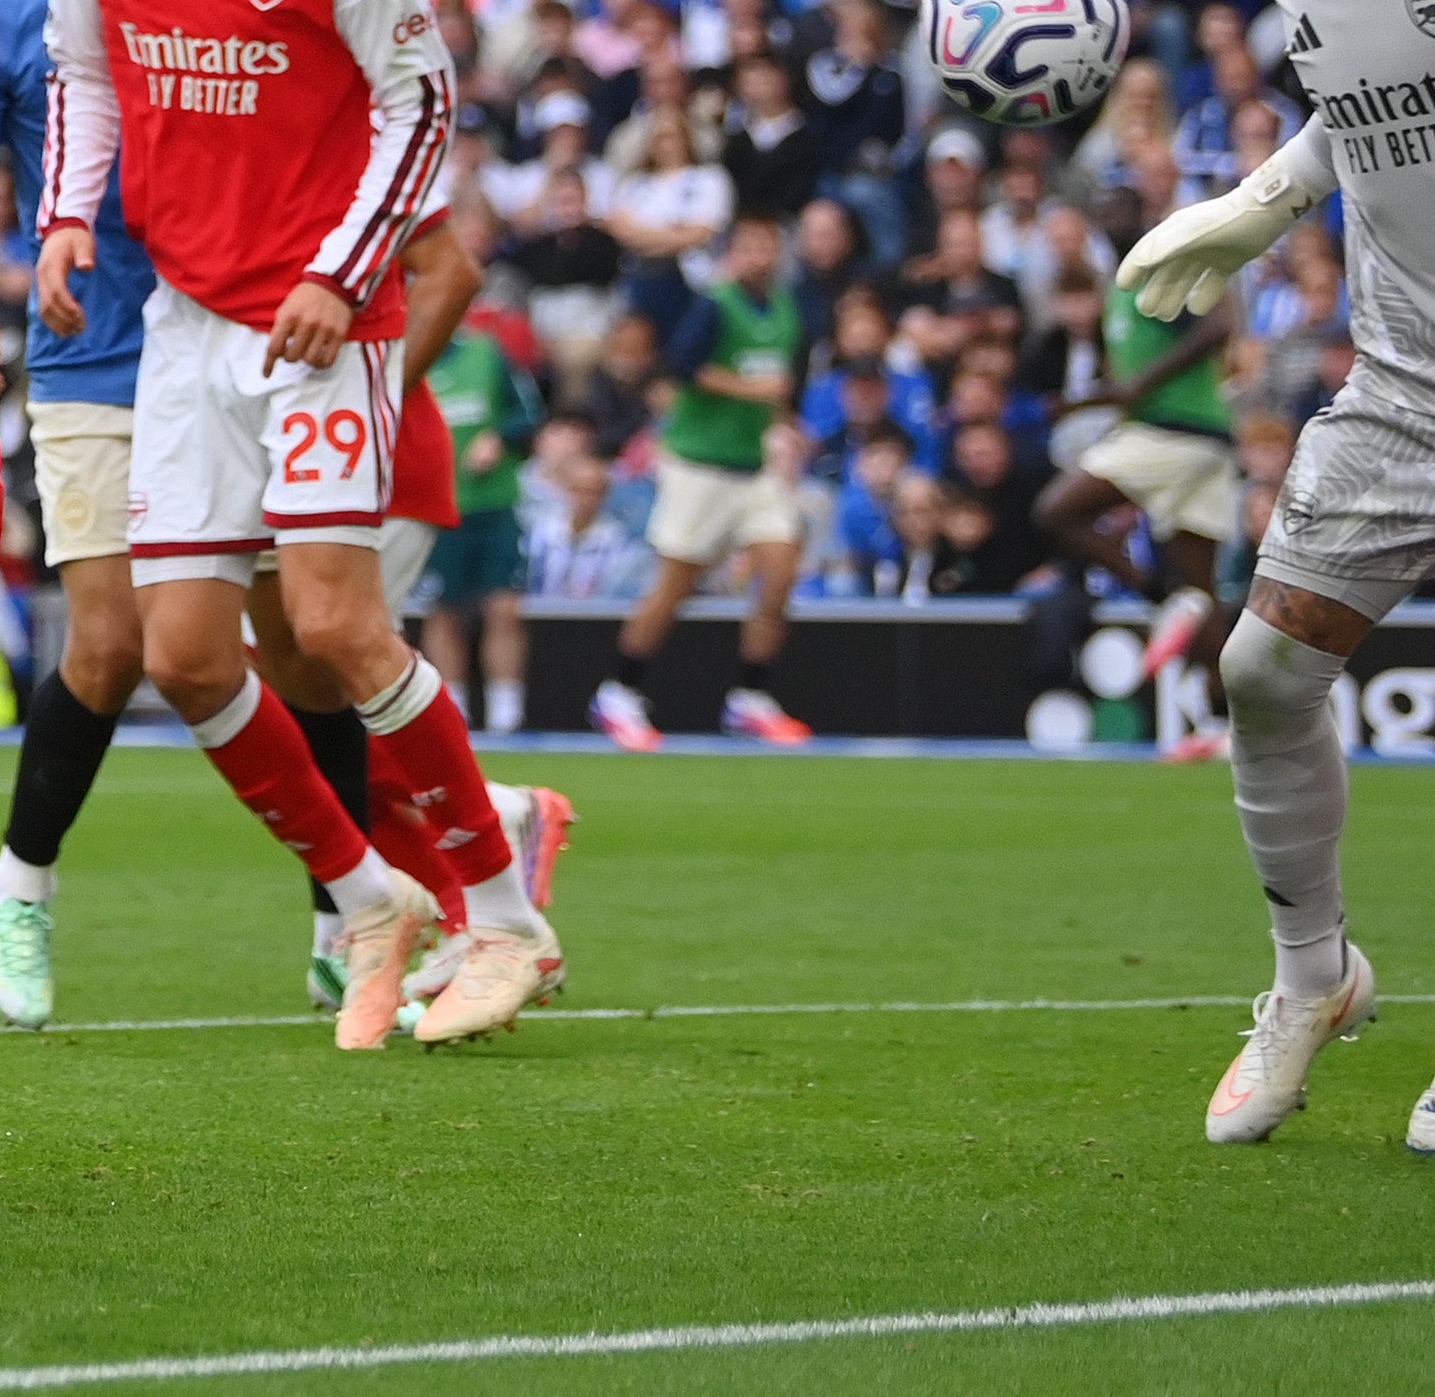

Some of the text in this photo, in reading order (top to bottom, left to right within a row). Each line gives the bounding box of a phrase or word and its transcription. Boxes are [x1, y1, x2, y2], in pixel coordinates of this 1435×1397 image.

[180, 75, 259, 116] BETTER
[1344, 135, 1380, 174] FLY
[283, 409, 367, 483] 29
